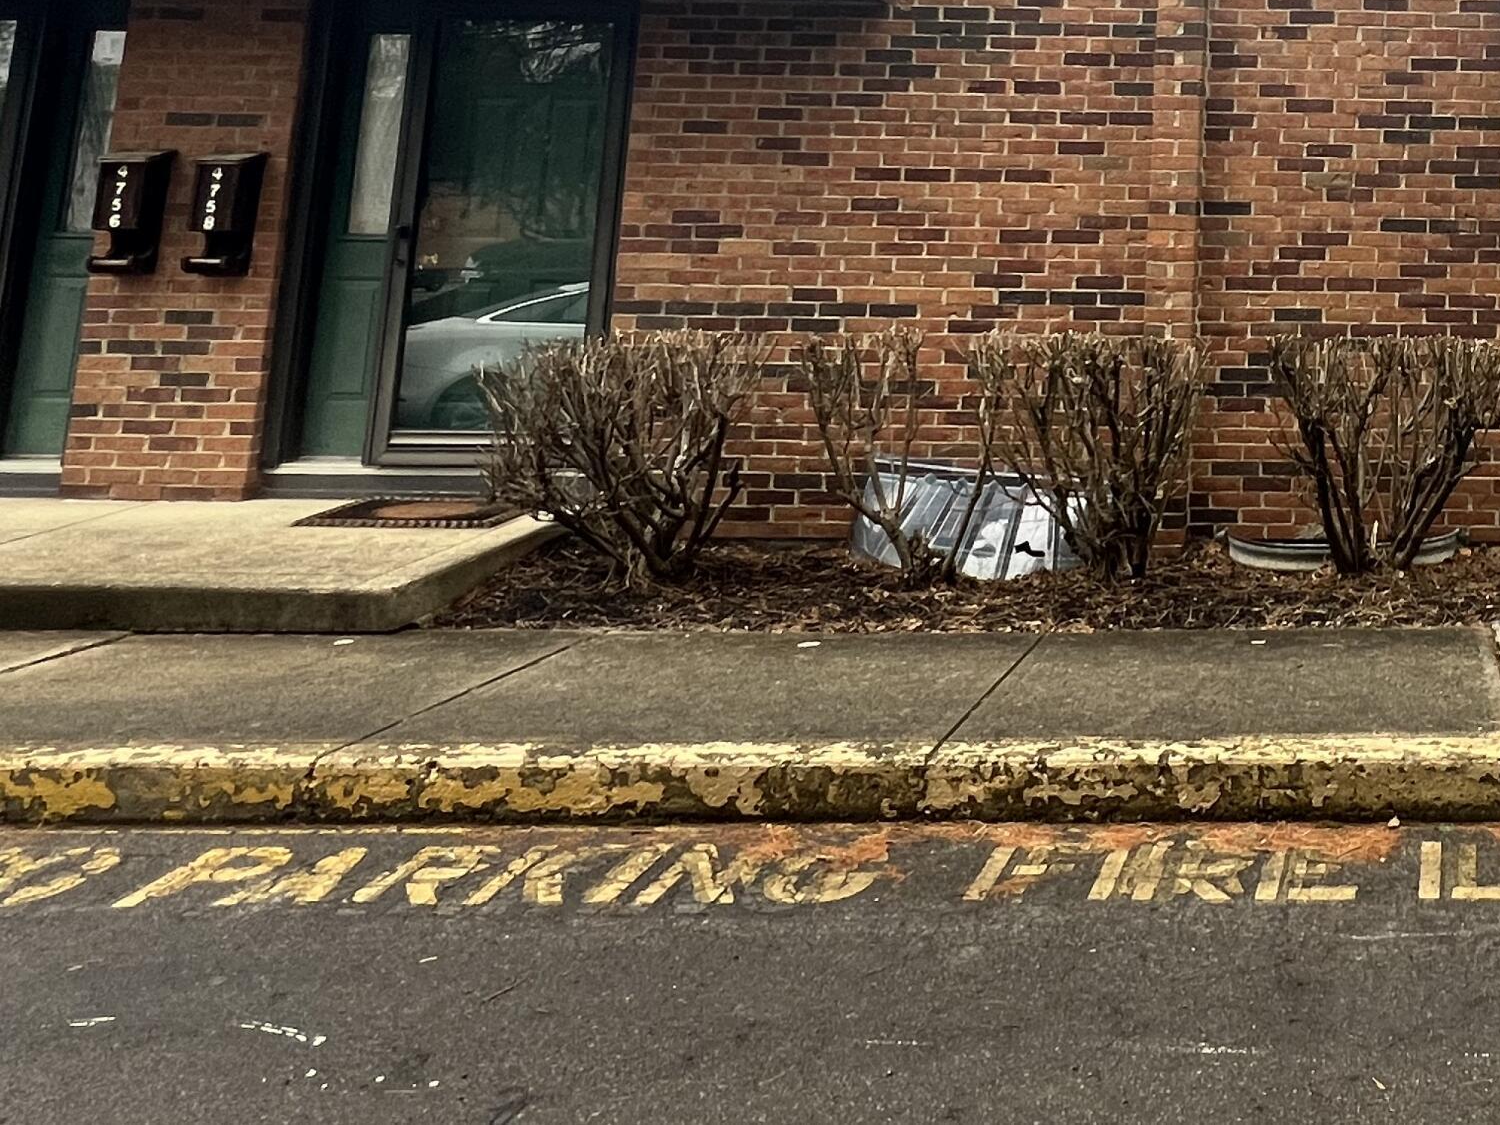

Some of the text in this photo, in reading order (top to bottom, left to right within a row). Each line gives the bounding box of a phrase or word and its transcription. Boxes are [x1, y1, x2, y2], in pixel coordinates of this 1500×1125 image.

[109, 165, 128, 228] 4756
[202, 167, 223, 231] 4758
[111, 844, 878, 907] PARKING
[962, 841, 1358, 902] FIRE
